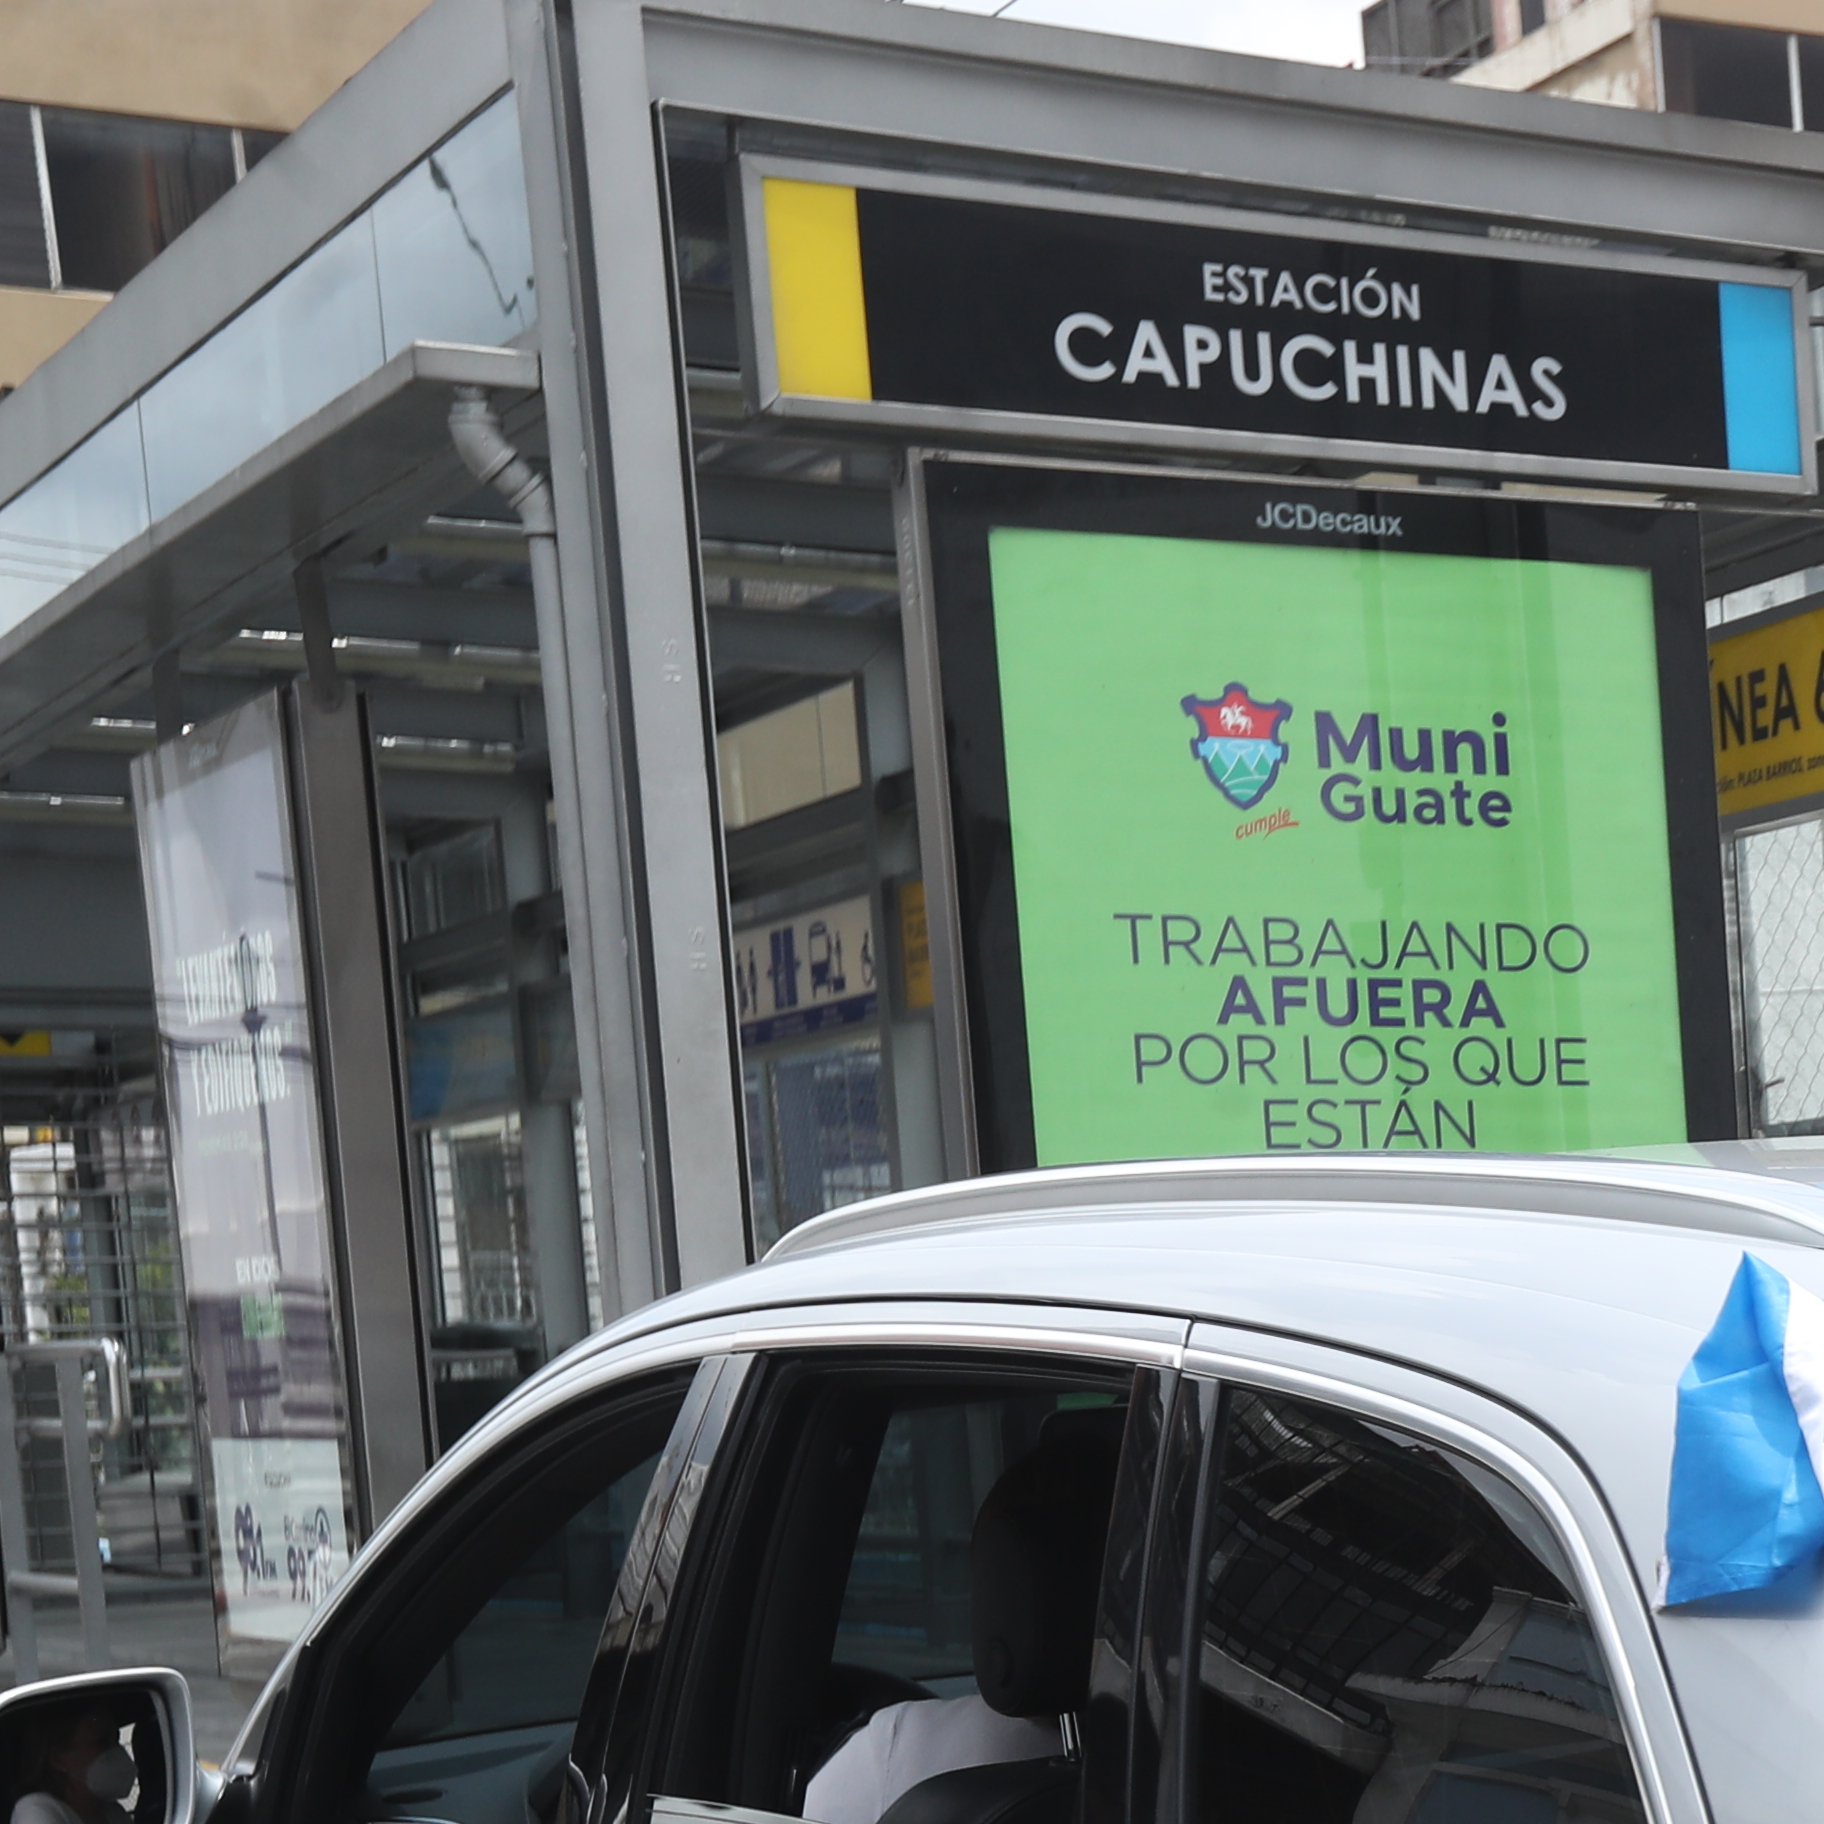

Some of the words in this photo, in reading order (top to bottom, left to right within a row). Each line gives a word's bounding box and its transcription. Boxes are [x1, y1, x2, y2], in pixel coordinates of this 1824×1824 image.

[1203, 262, 1421, 322] ESTACIÓN
[1054, 312, 1567, 421] CAPUCHINAS
[1256, 501, 1403, 536] JCDecaux
[1710, 660, 1800, 751] NEA
[1314, 710, 1510, 776] Muni
[1321, 773, 1512, 828] Guate
[1737, 767, 1763, 787] PLAZA
[1235, 807, 1300, 841] cumple
[1113, 913, 1590, 973] TRABAJANDO
[1216, 974, 1507, 1029] AFUERA
[1133, 1032, 1279, 1086] POR
[1302, 1034, 1430, 1087] LOS
[1453, 1035, 1590, 1087] QUE
[1262, 1085, 1477, 1150] ESTÁN
